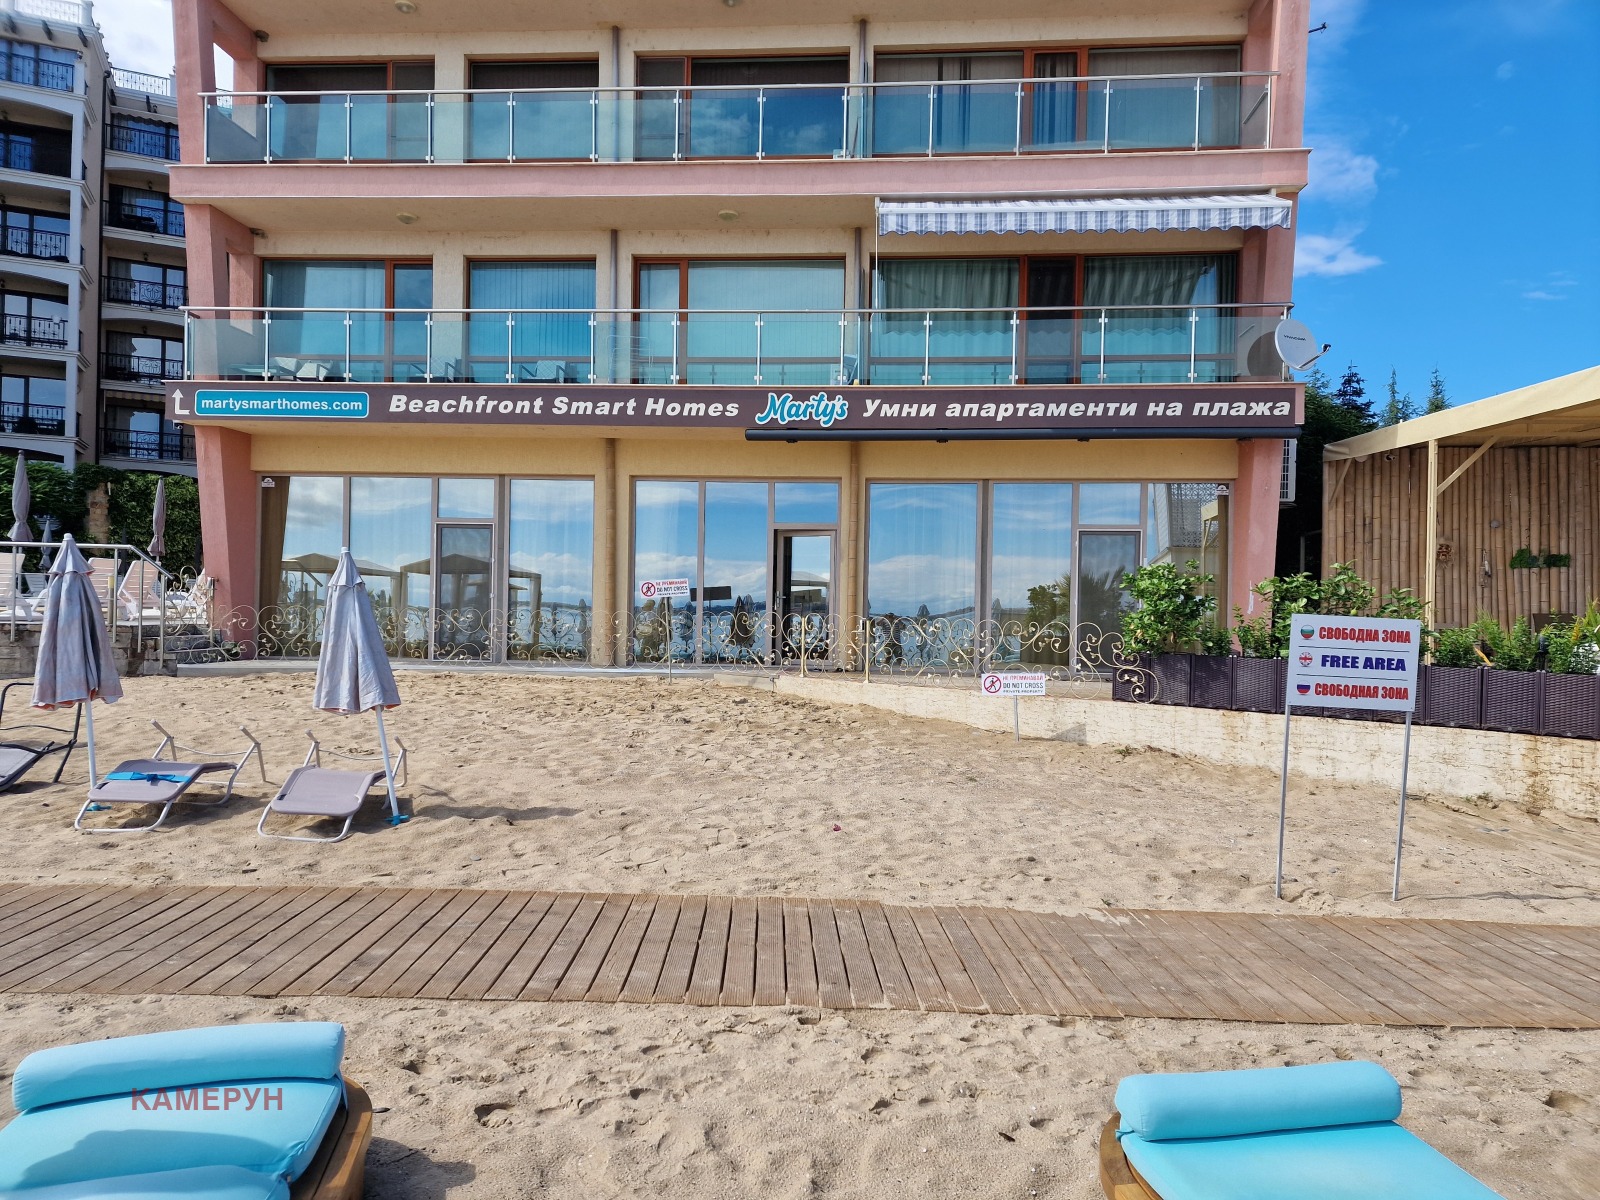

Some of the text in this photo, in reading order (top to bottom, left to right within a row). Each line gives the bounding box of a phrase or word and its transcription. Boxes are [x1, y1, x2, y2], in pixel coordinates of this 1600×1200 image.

[201, 397, 363, 411] martysmarthomes.com
[389, 394, 740, 416] Beachfront Smart Homes
[755, 391, 849, 428] Marty's
[863, 399, 1291, 421] Умни апартаменти на плажа
[1319, 626, 1411, 643] СВОБОДНА ЗОНА
[1321, 655, 1407, 671] FREE AREA
[1314, 683, 1409, 700] СВОБОДНАЯ ЗОНА
